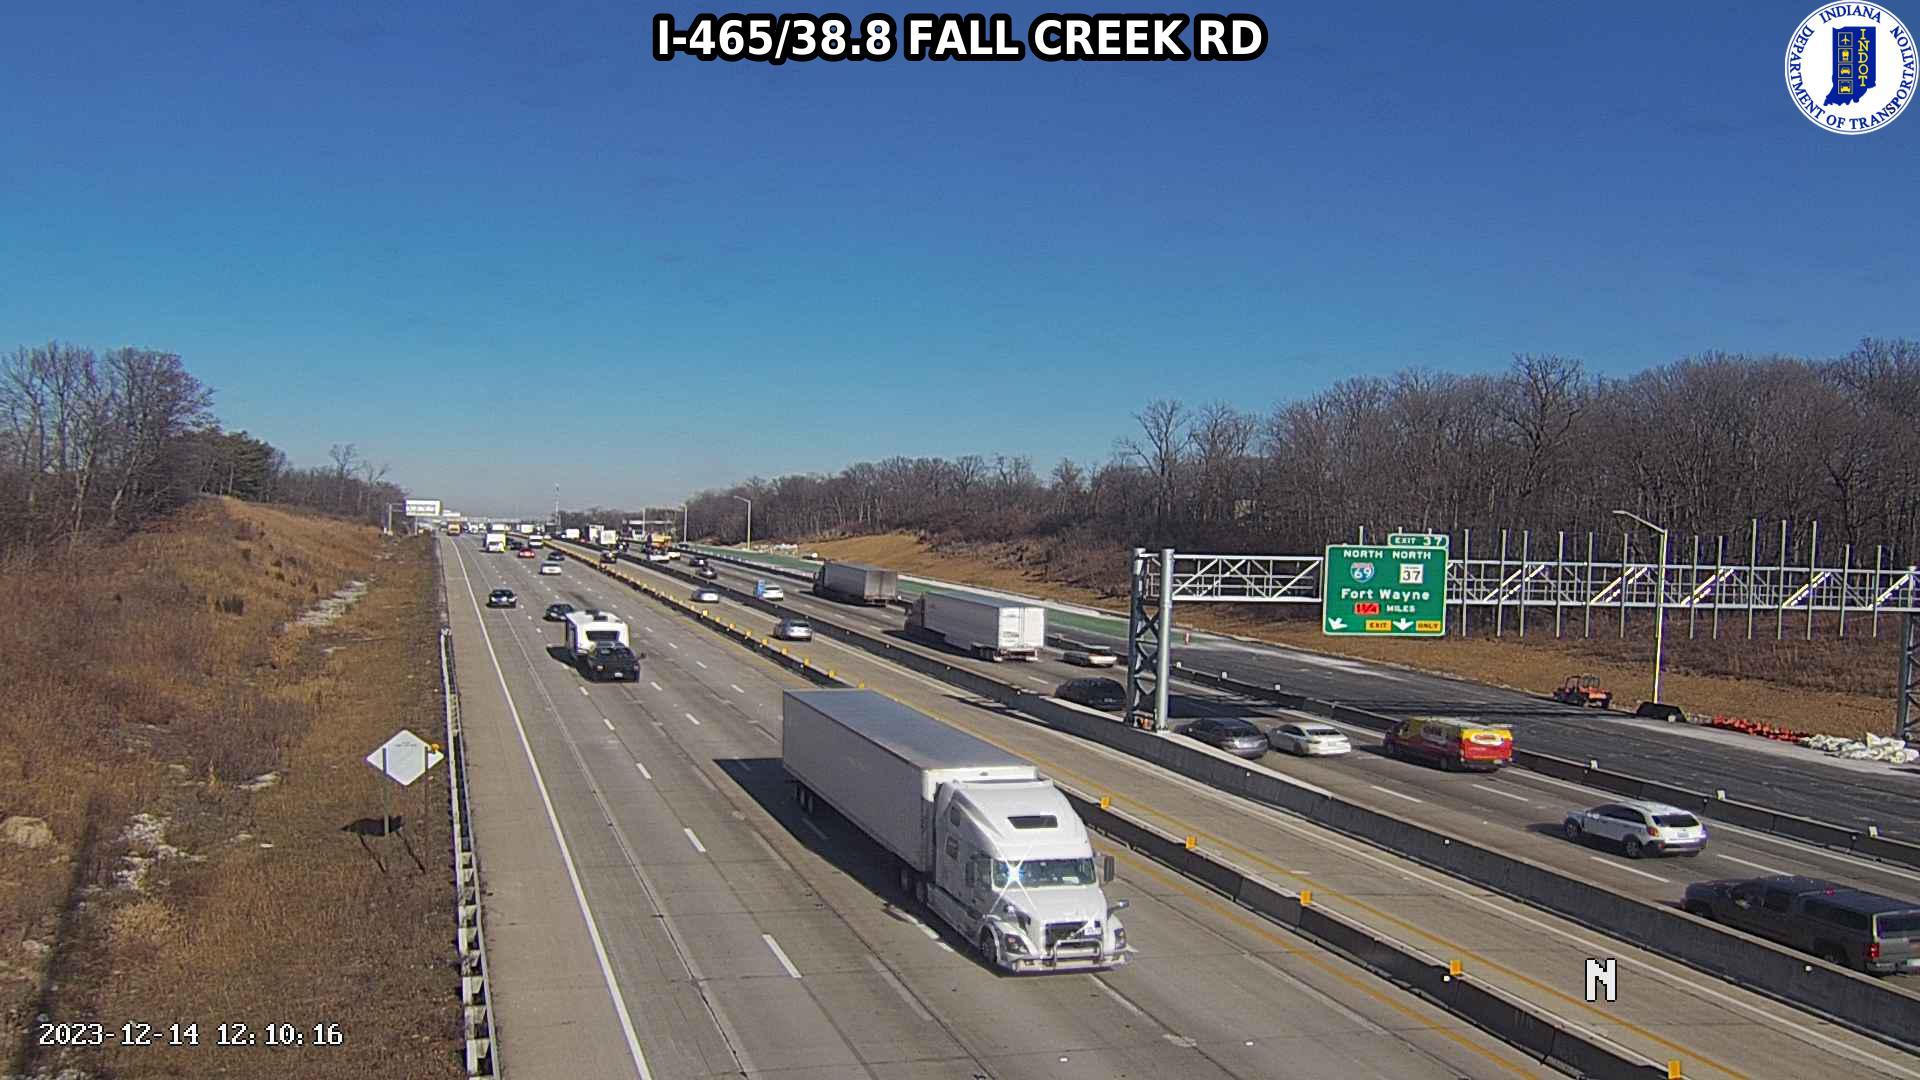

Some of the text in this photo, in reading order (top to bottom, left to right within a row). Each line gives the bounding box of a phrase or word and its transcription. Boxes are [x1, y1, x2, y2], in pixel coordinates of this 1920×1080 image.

[1394, 535, 1443, 546] EXIT 37
[1343, 549, 1384, 559] NORTH
[1392, 550, 1432, 560] NORTH
[1353, 566, 1373, 580] 69
[1402, 570, 1421, 581] 37
[1341, 588, 1430, 603] Fort Wayne
[1386, 604, 1416, 613] MILES
